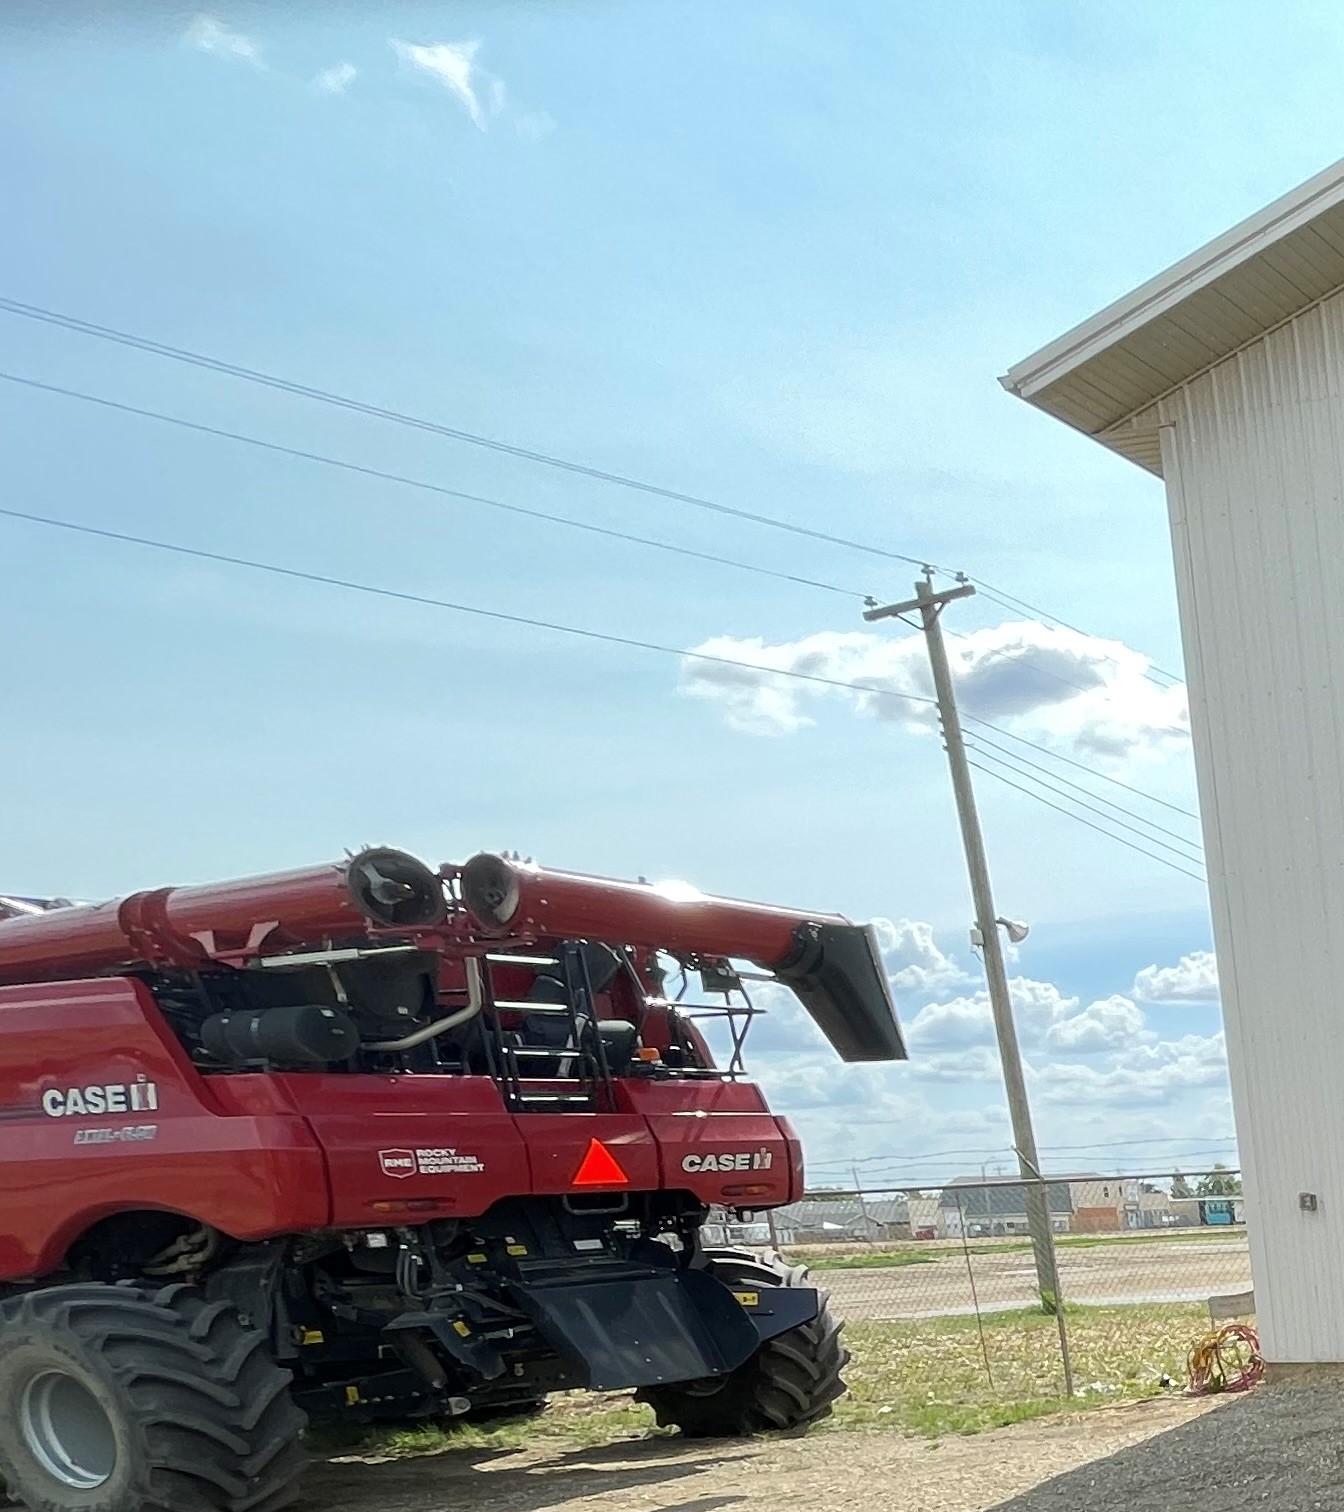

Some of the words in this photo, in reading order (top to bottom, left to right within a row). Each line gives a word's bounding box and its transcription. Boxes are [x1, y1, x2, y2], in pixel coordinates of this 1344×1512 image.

[42, 1084, 128, 1117] CASE
[416, 1148, 456, 1157] ROCKY
[418, 1156, 478, 1165] MOUNTAIN
[682, 1153, 751, 1173] CASE
[419, 1163, 485, 1174] EQUIPMENT
